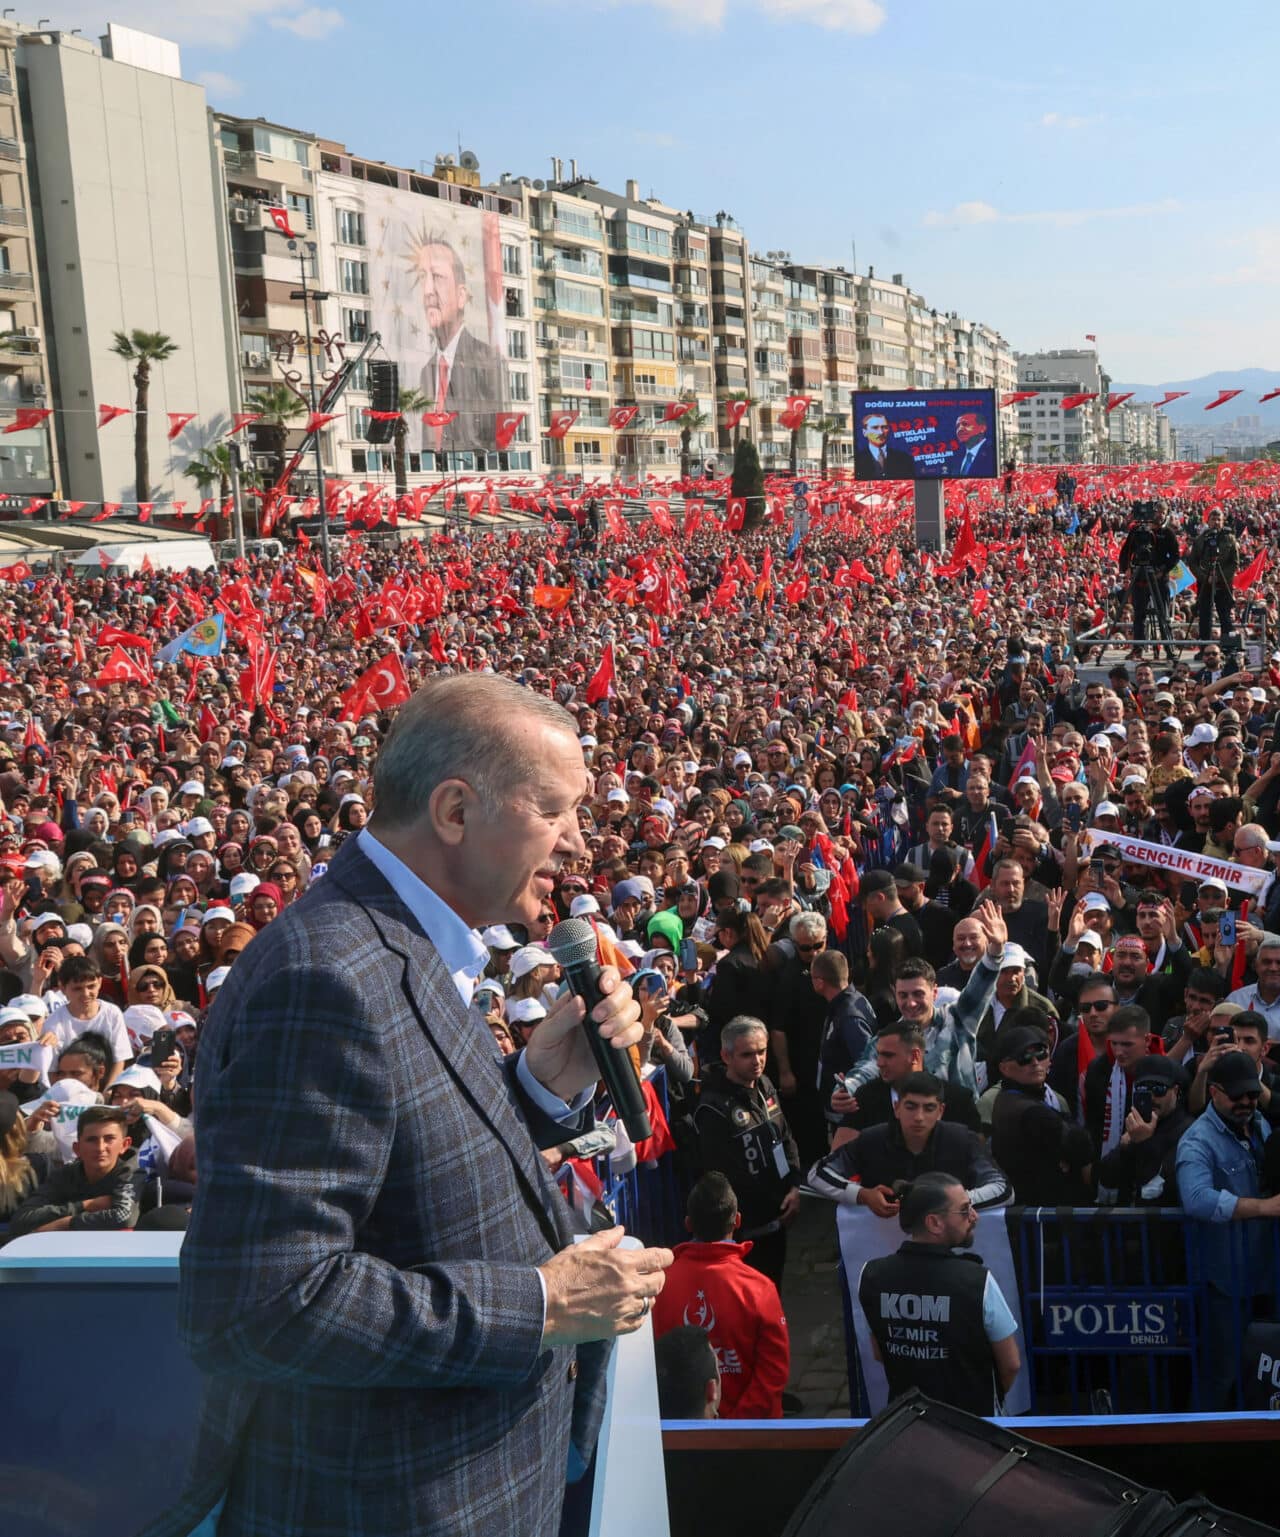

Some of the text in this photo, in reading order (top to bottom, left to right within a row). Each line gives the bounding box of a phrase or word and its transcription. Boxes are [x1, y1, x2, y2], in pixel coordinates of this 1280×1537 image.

[1125, 845, 1243, 884] GENÇLİK İZMİR
[880, 1293, 950, 1322] KOM
[1049, 1301, 1165, 1335] POLİS
[888, 1324, 939, 1342] İZMİR
